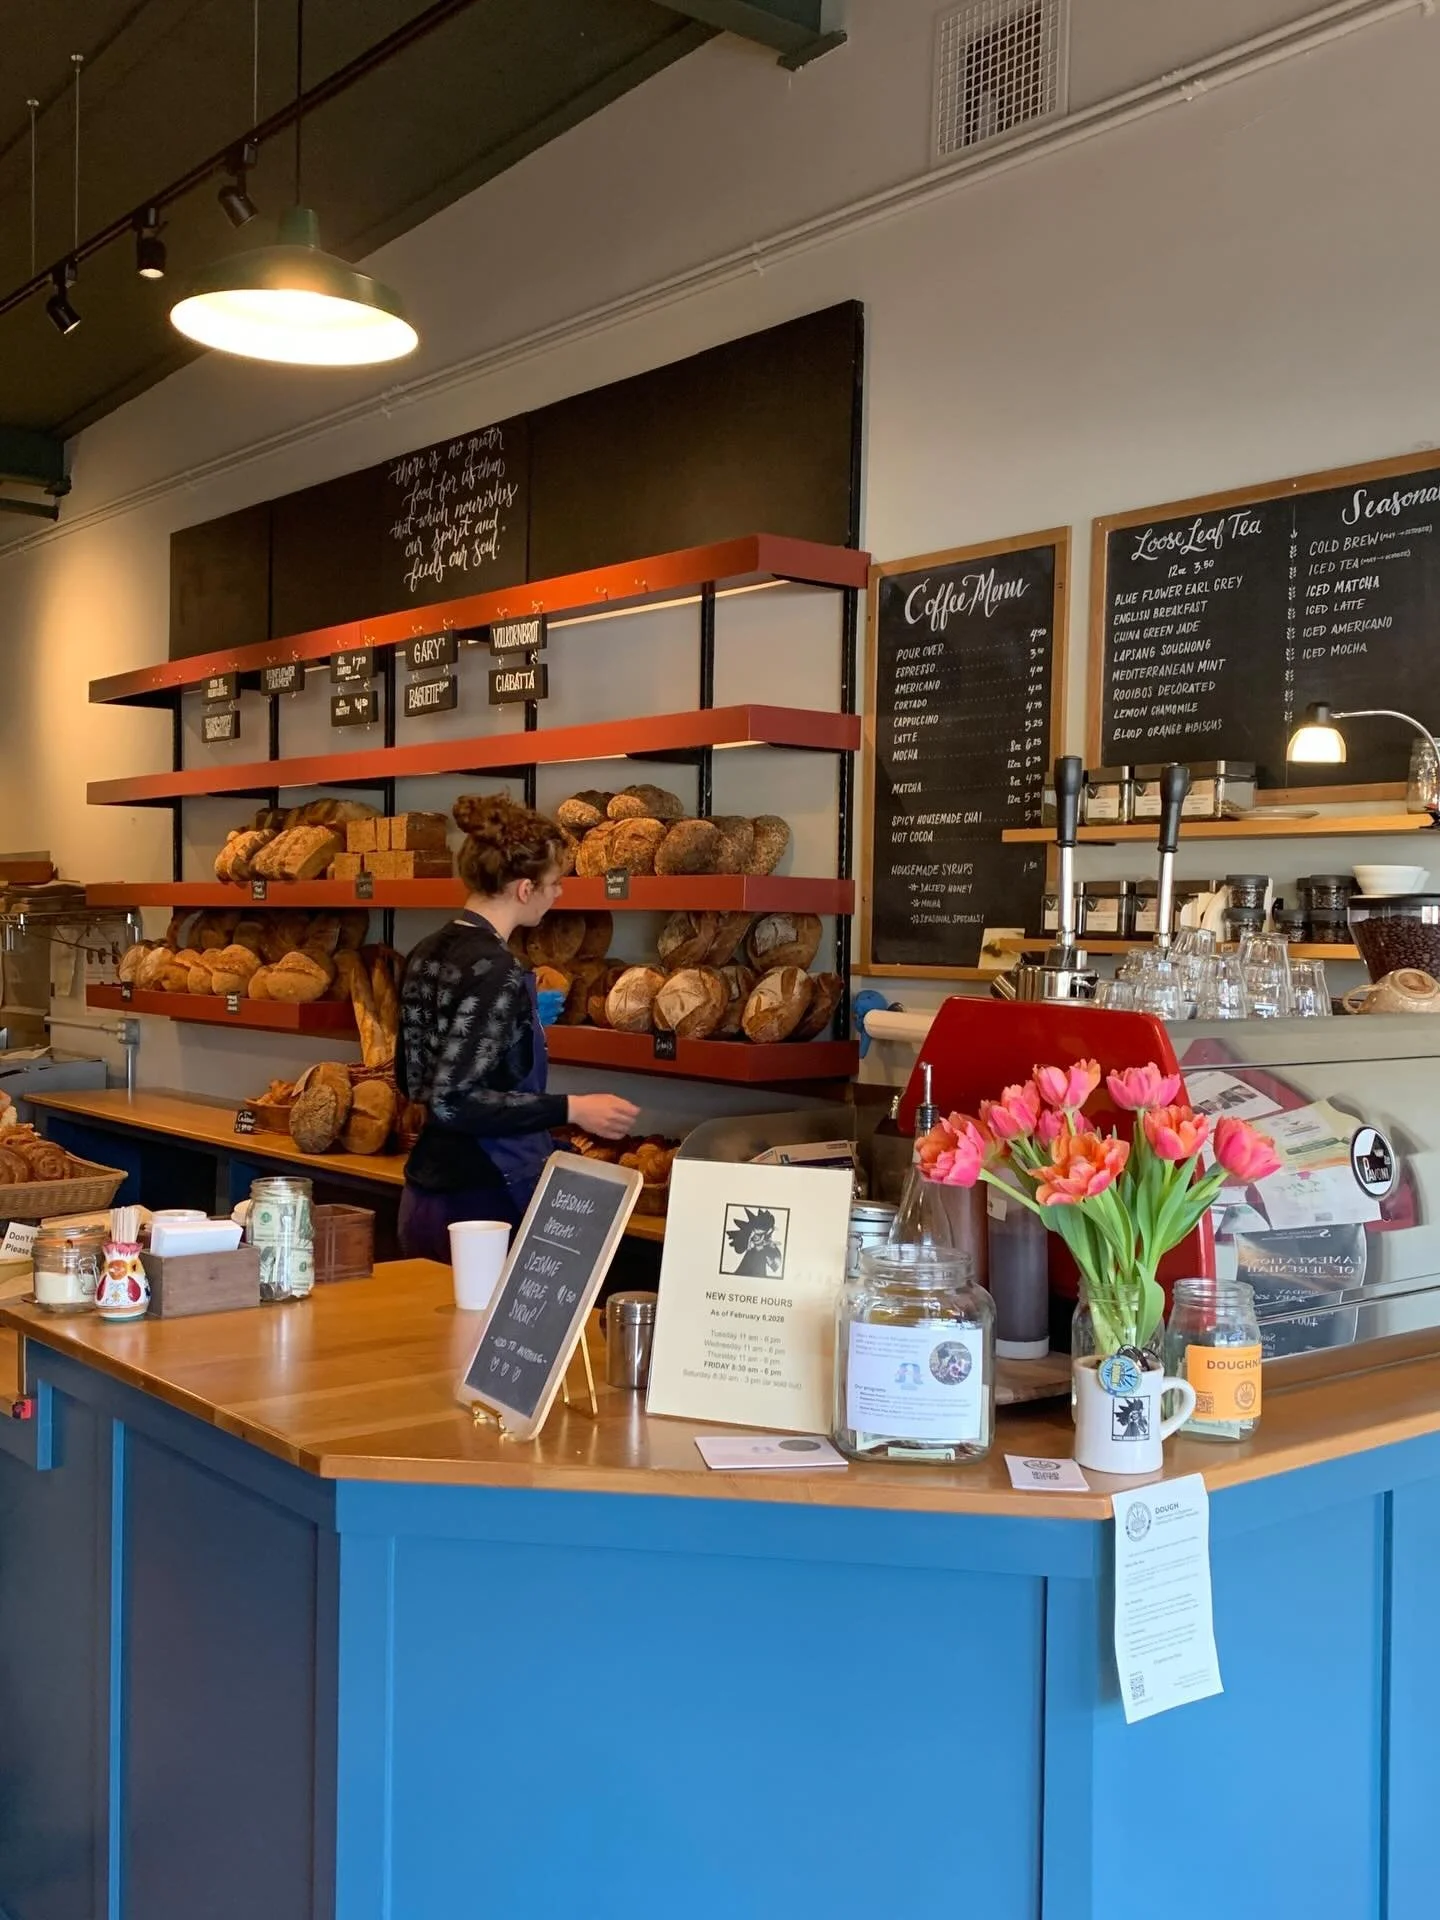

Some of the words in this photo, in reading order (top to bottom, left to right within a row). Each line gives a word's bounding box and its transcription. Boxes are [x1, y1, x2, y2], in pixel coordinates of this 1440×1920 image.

[428, 450, 441, 473] is
[448, 442, 464, 460] no
[402, 478, 434, 514] food
[434, 471, 459, 499] for
[389, 516, 416, 539] that
[416, 503, 449, 528] which
[454, 479, 519, 518] nourishes
[405, 536, 424, 557] our
[432, 514, 472, 551] spirit
[475, 508, 499, 534] and
[1131, 528, 1185, 561] Loose
[1180, 518, 1224, 555] Leaf
[1227, 510, 1262, 540] Tea
[1309, 540, 1340, 556] COLD
[1343, 531, 1380, 552] BREW
[448, 543, 469, 571] our
[1309, 561, 1336, 576] ICED
[1340, 557, 1360, 571] TEA
[1114, 591, 1138, 606] BLUE
[1142, 584, 1182, 603] FLOWER
[1184, 582, 1210, 597] EARL
[1213, 575, 1243, 592] GREY
[1306, 583, 1330, 598] ICED
[1334, 575, 1380, 594] MATCHA
[904, 577, 972, 631] Coffee
[961, 567, 1031, 618] Menu
[1305, 604, 1329, 616] ICED
[1333, 598, 1366, 612] LATTE
[1113, 608, 1151, 625] ENGLISH
[1153, 600, 1208, 618] BREAKFAST
[1114, 629, 1141, 643] CHINA
[1143, 624, 1174, 638] GREEN
[1176, 620, 1201, 635] JADE
[1302, 625, 1327, 638] ICED
[1330, 616, 1393, 635] AMERICANO
[896, 648, 920, 662] POUR
[922, 643, 944, 657] OVER
[1114, 647, 1155, 662] LAPSANG
[1160, 639, 1211, 656] SOUCHONG
[1302, 647, 1326, 660] ICED
[1330, 642, 1368, 656] MOCHA
[895, 663, 936, 678] ESPRESSO
[1112, 663, 1194, 682] MEDITERRANEAN
[1197, 659, 1226, 673] MINT
[496, 670, 535, 692] CIABATTA
[894, 680, 941, 695] AMERICANO
[409, 683, 440, 709] BAGUETTE
[1113, 685, 1152, 701] ROOIBOS
[1157, 681, 1216, 697] DECORATED
[894, 699, 927, 710] CORTADO
[1113, 706, 1148, 719] LEMON
[1151, 702, 1198, 716] CHAMOMILE
[893, 714, 939, 728] CAPPUCCINO
[1113, 727, 1142, 740] BLOOD
[1147, 723, 1182, 737] ORANGE
[1185, 719, 1223, 733] HIBISCUS
[893, 733, 918, 745] LATTE
[892, 749, 918, 762] MOCHA
[891, 783, 922, 795] MATCHA
[891, 815, 915, 827] SPICY
[916, 812, 962, 825] HOUSEMADE
[963, 811, 983, 823] CHAI
[892, 832, 908, 843] HOT
[909, 830, 933, 843] COCOA
[891, 864, 938, 876] HOUSEMADE
[941, 863, 974, 875] SYRUPS
[947, 883, 973, 894] HONEY
[551, 1188, 595, 1215] SEASONAL
[9, 1231, 29, 1243] Don't
[524, 1251, 564, 1278] SESAME
[517, 1278, 549, 1301] MAPLE
[705, 1291, 727, 1301] NEW
[728, 1293, 759, 1305] STORE
[761, 1297, 793, 1308] HOURS
[710, 1309, 720, 1317] As
[721, 1310, 730, 1318] of
[730, 1311, 760, 1322] February
[711, 1330, 737, 1340] Tuesday
[703, 1361, 730, 1370] FRIDAY
[771, 1370, 782, 1378] pm
[1154, 1502, 1180, 1515] DOUGH
